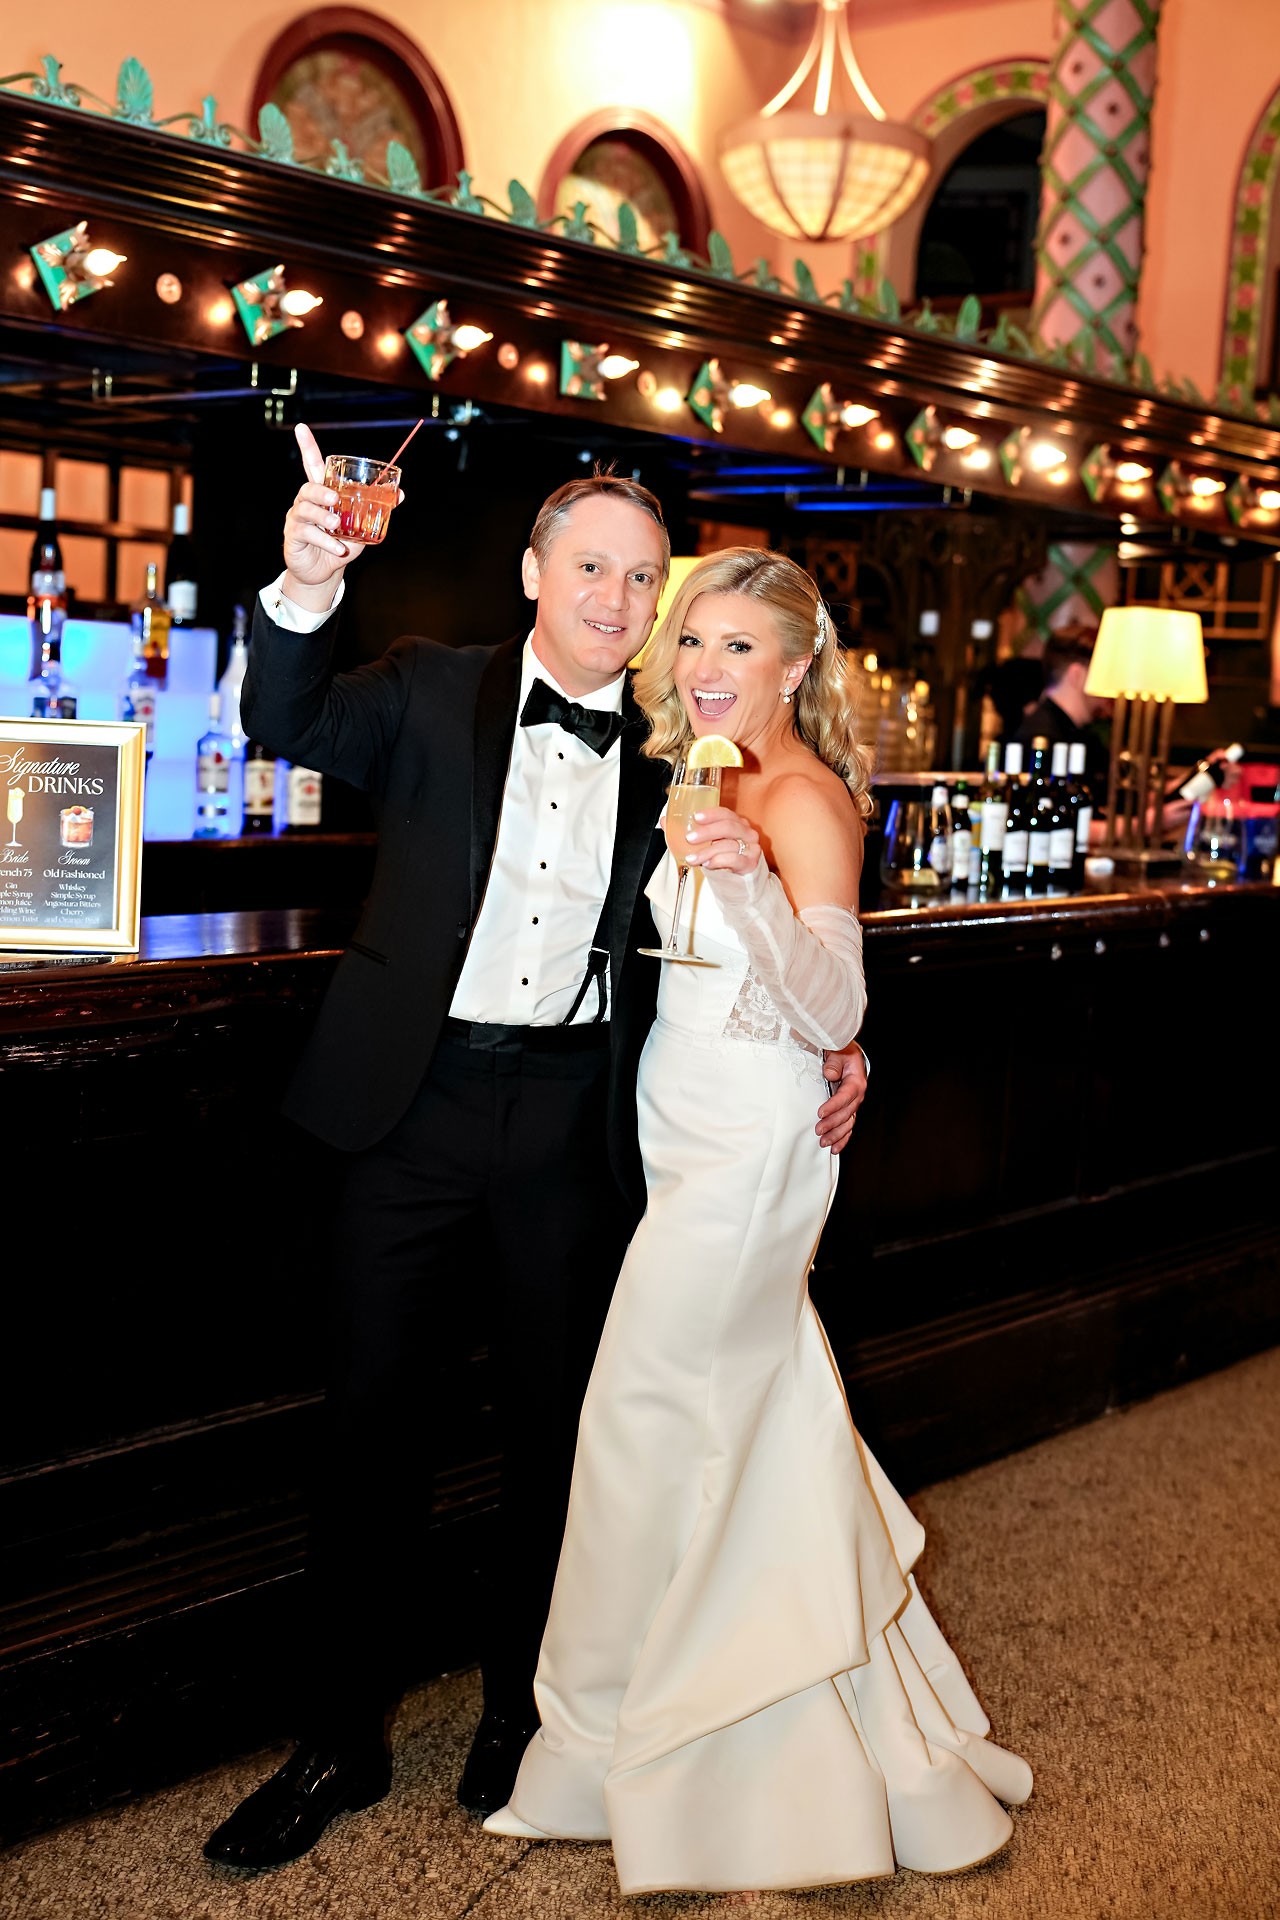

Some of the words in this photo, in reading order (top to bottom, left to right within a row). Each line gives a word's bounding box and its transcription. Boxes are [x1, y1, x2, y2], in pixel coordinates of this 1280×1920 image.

[0, 747, 80, 786] Signature
[28, 776, 104, 795] DRINKS
[0, 848, 29, 864] Bride
[57, 850, 91, 866] Groom
[23, 868, 33, 877] 75
[43, 869, 60, 878] Old
[61, 870, 105, 879] Fashioned
[59, 883, 86, 892] Whiskey
[12, 890, 33, 900] Syrup
[50, 891, 75, 901] Simple
[75, 892, 97, 901] Syrup
[14, 899, 32, 907] Juice
[43, 900, 79, 908] Angostura
[79, 901, 102, 909] Bitters
[60, 908, 84, 917] Cherry
[44, 915, 58, 923] and
